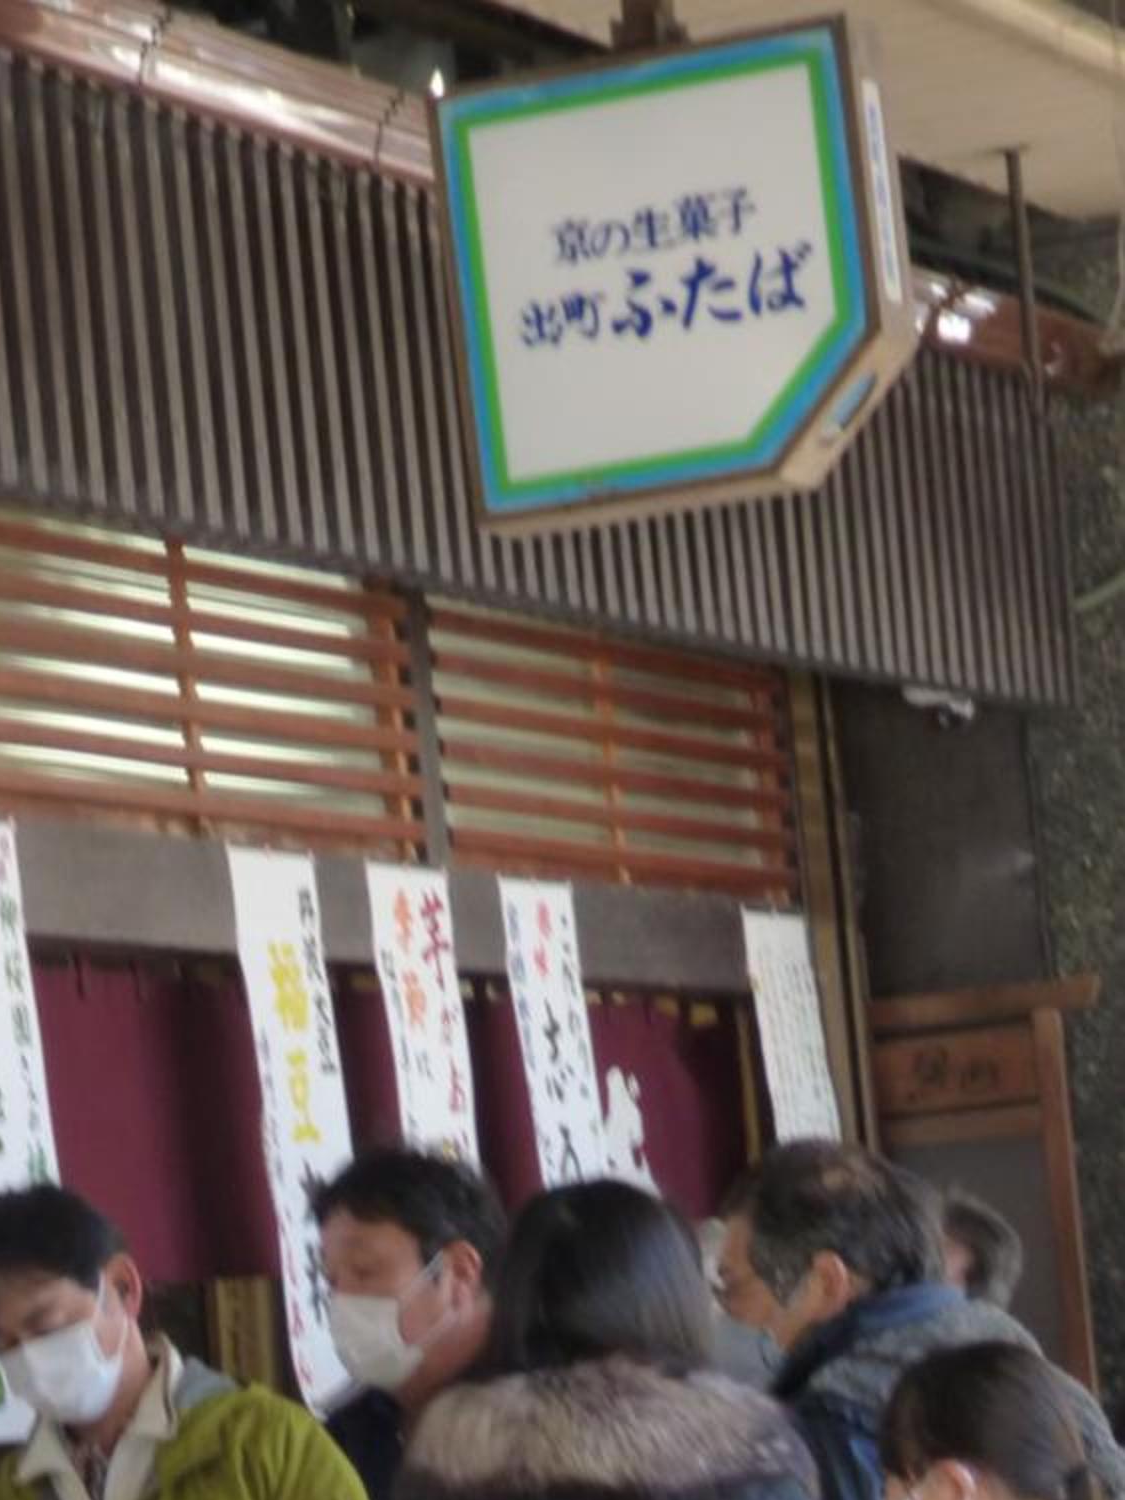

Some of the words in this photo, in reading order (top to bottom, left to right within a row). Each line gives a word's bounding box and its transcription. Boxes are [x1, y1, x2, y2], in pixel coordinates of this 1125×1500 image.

[552, 187, 755, 266] 京の生菓子
[520, 240, 813, 350] 出町ふたば
